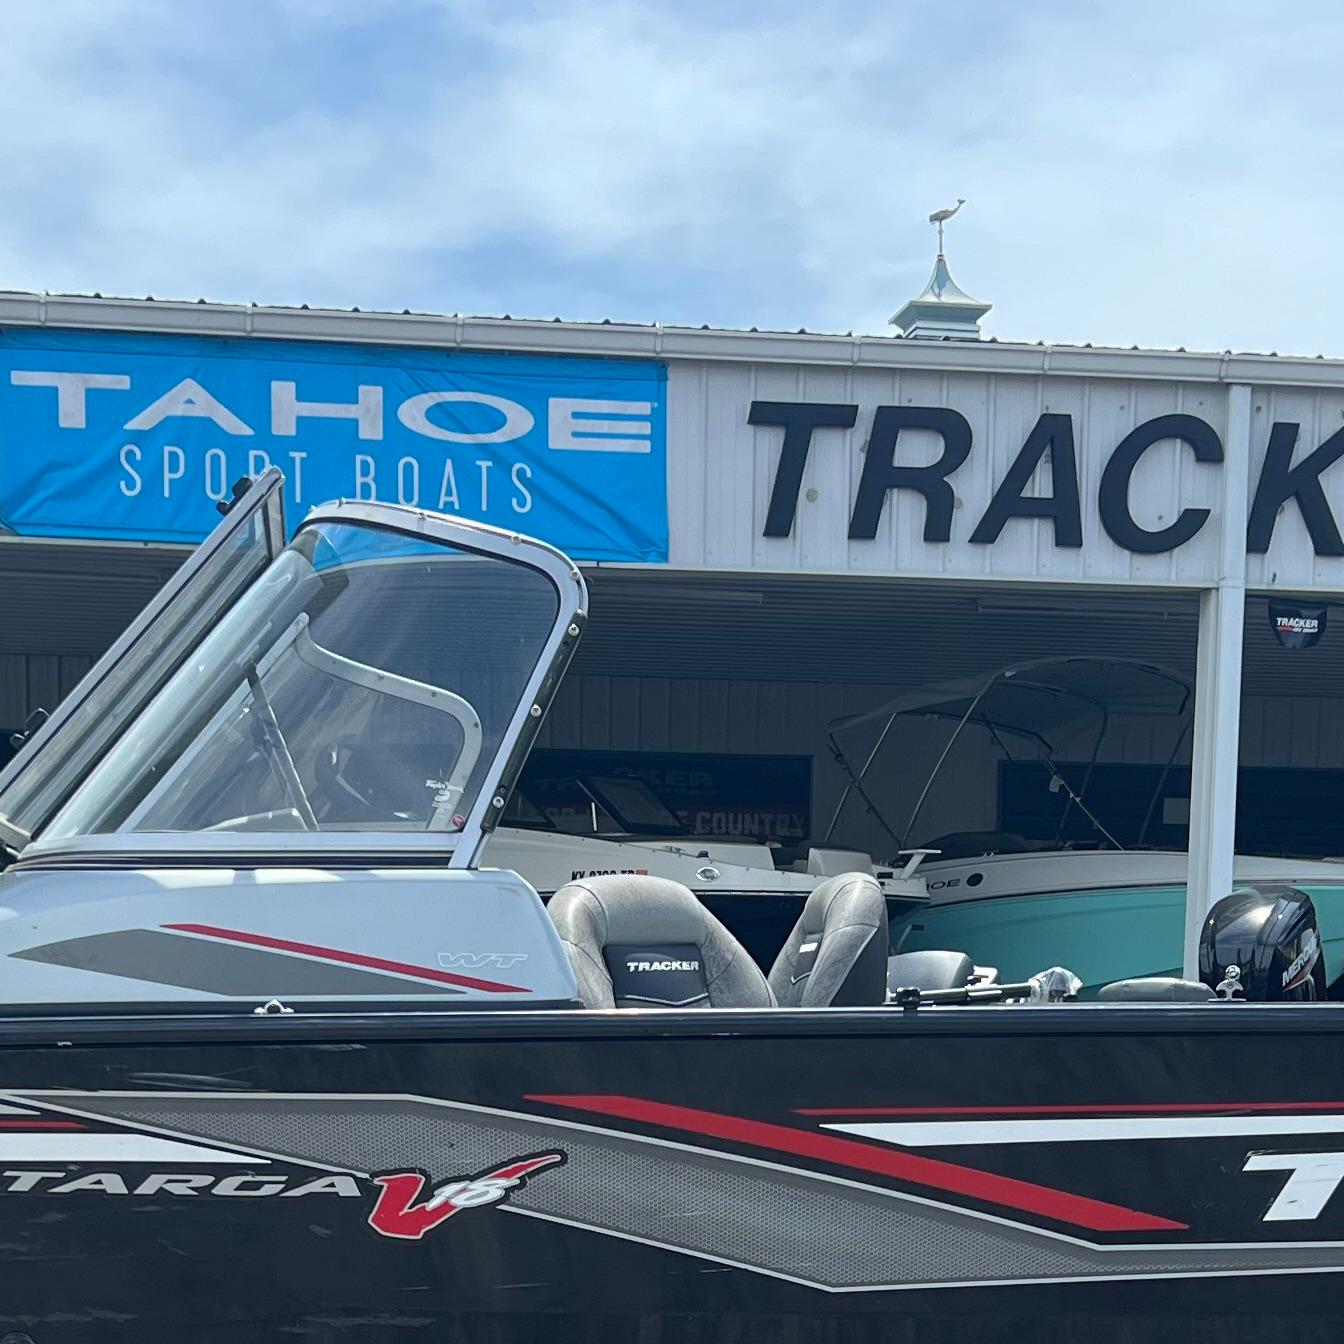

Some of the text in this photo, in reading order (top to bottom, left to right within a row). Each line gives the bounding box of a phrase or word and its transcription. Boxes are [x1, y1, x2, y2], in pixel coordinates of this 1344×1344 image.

[10, 370, 651, 453] TAHOE
[356, 454, 533, 514] BOATS
[1276, 617, 1318, 628] TRACKER
[437, 952, 529, 969] WT
[627, 960, 699, 972] TRACKER
[2, 1170, 362, 1198] TARGA
